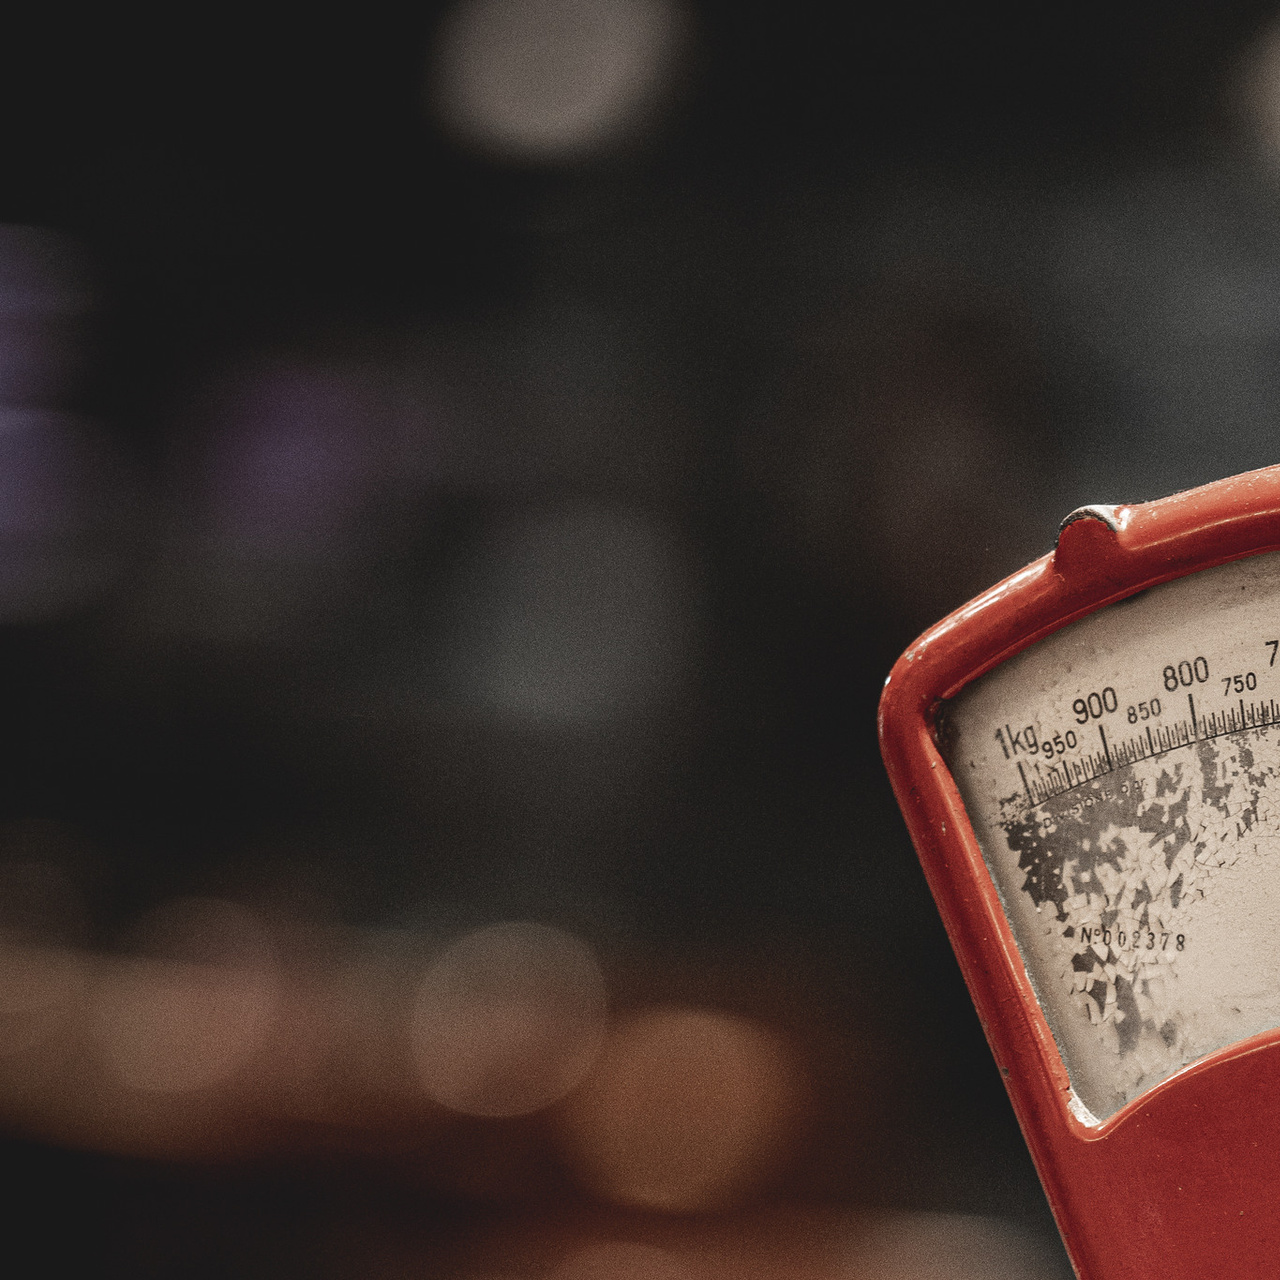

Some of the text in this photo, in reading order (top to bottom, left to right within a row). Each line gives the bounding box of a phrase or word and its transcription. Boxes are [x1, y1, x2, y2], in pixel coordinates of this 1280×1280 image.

[995, 724, 1039, 760] 1kg
[1041, 730, 1078, 760] 950
[1073, 687, 1118, 725] 900
[1127, 698, 1162, 724] 850
[1163, 656, 1210, 692] 800
[1221, 672, 1257, 697] 750
